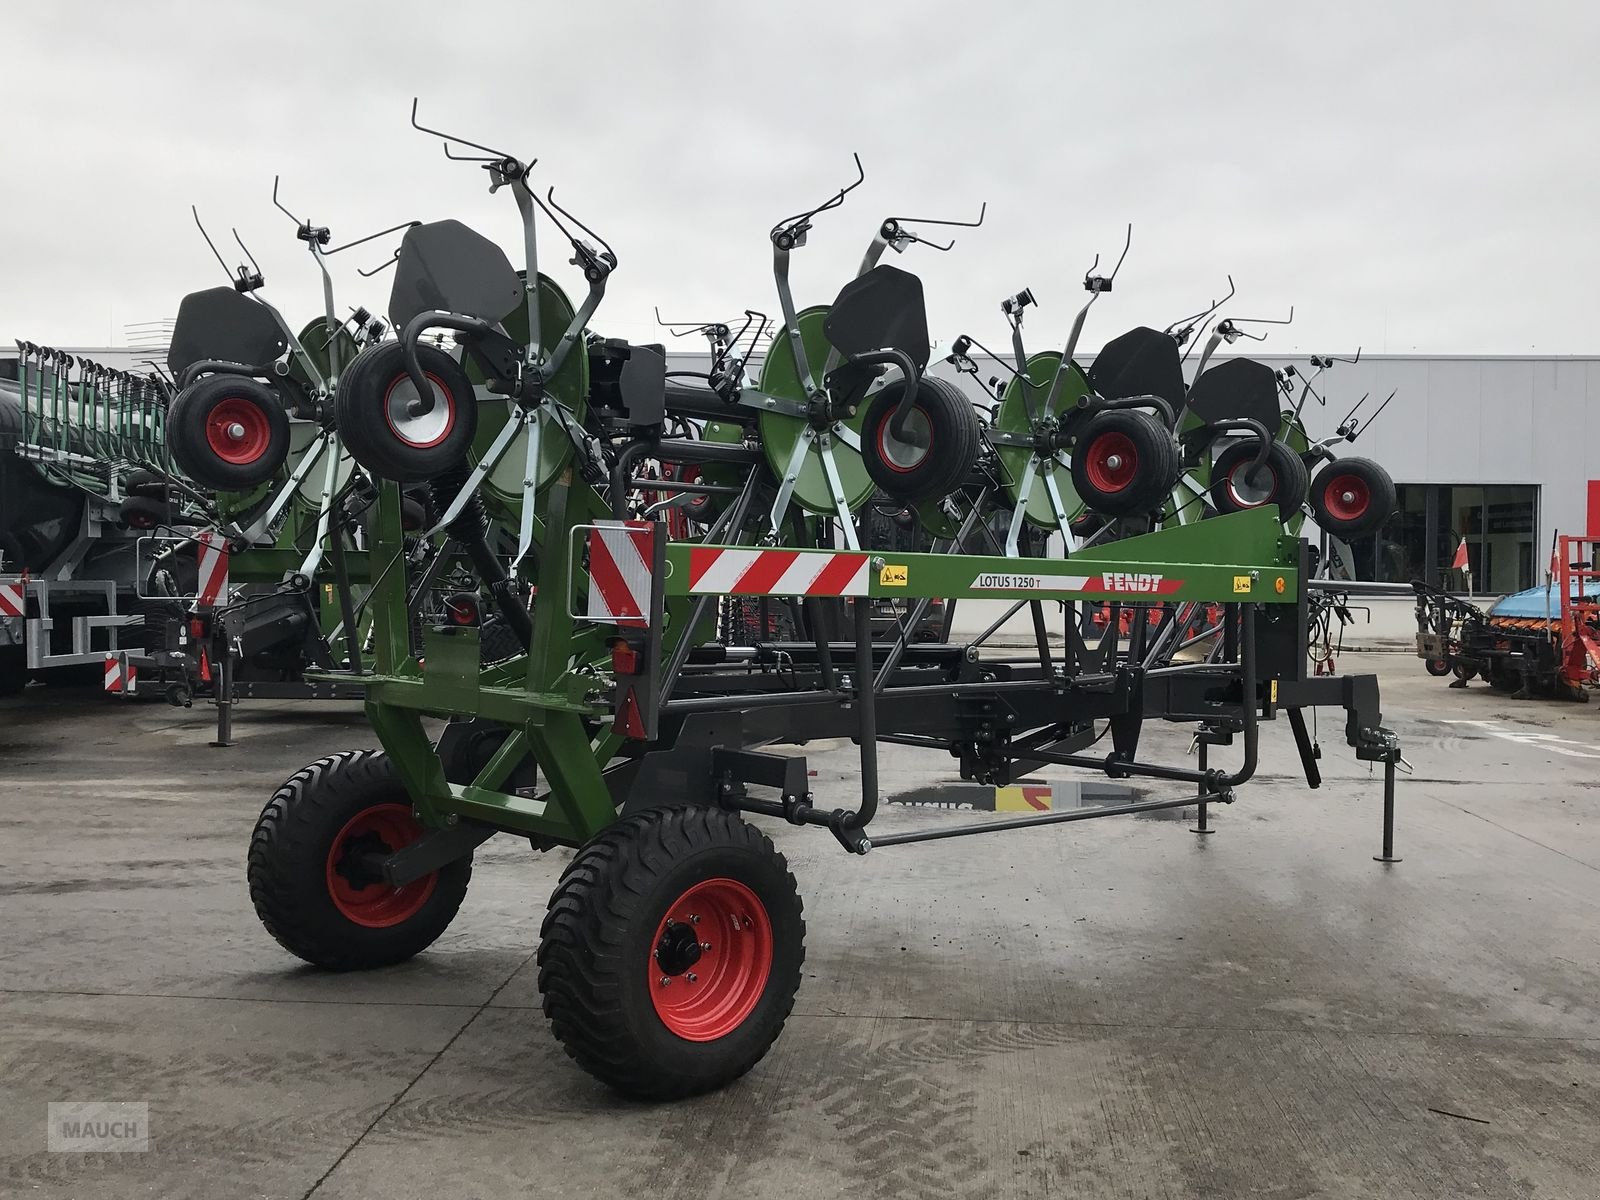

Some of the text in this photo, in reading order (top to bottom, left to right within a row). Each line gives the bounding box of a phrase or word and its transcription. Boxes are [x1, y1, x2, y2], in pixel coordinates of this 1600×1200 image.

[980, 575, 1010, 588] LOTUS
[1012, 576, 1035, 588] 1250
[1102, 572, 1163, 592] FENDT
